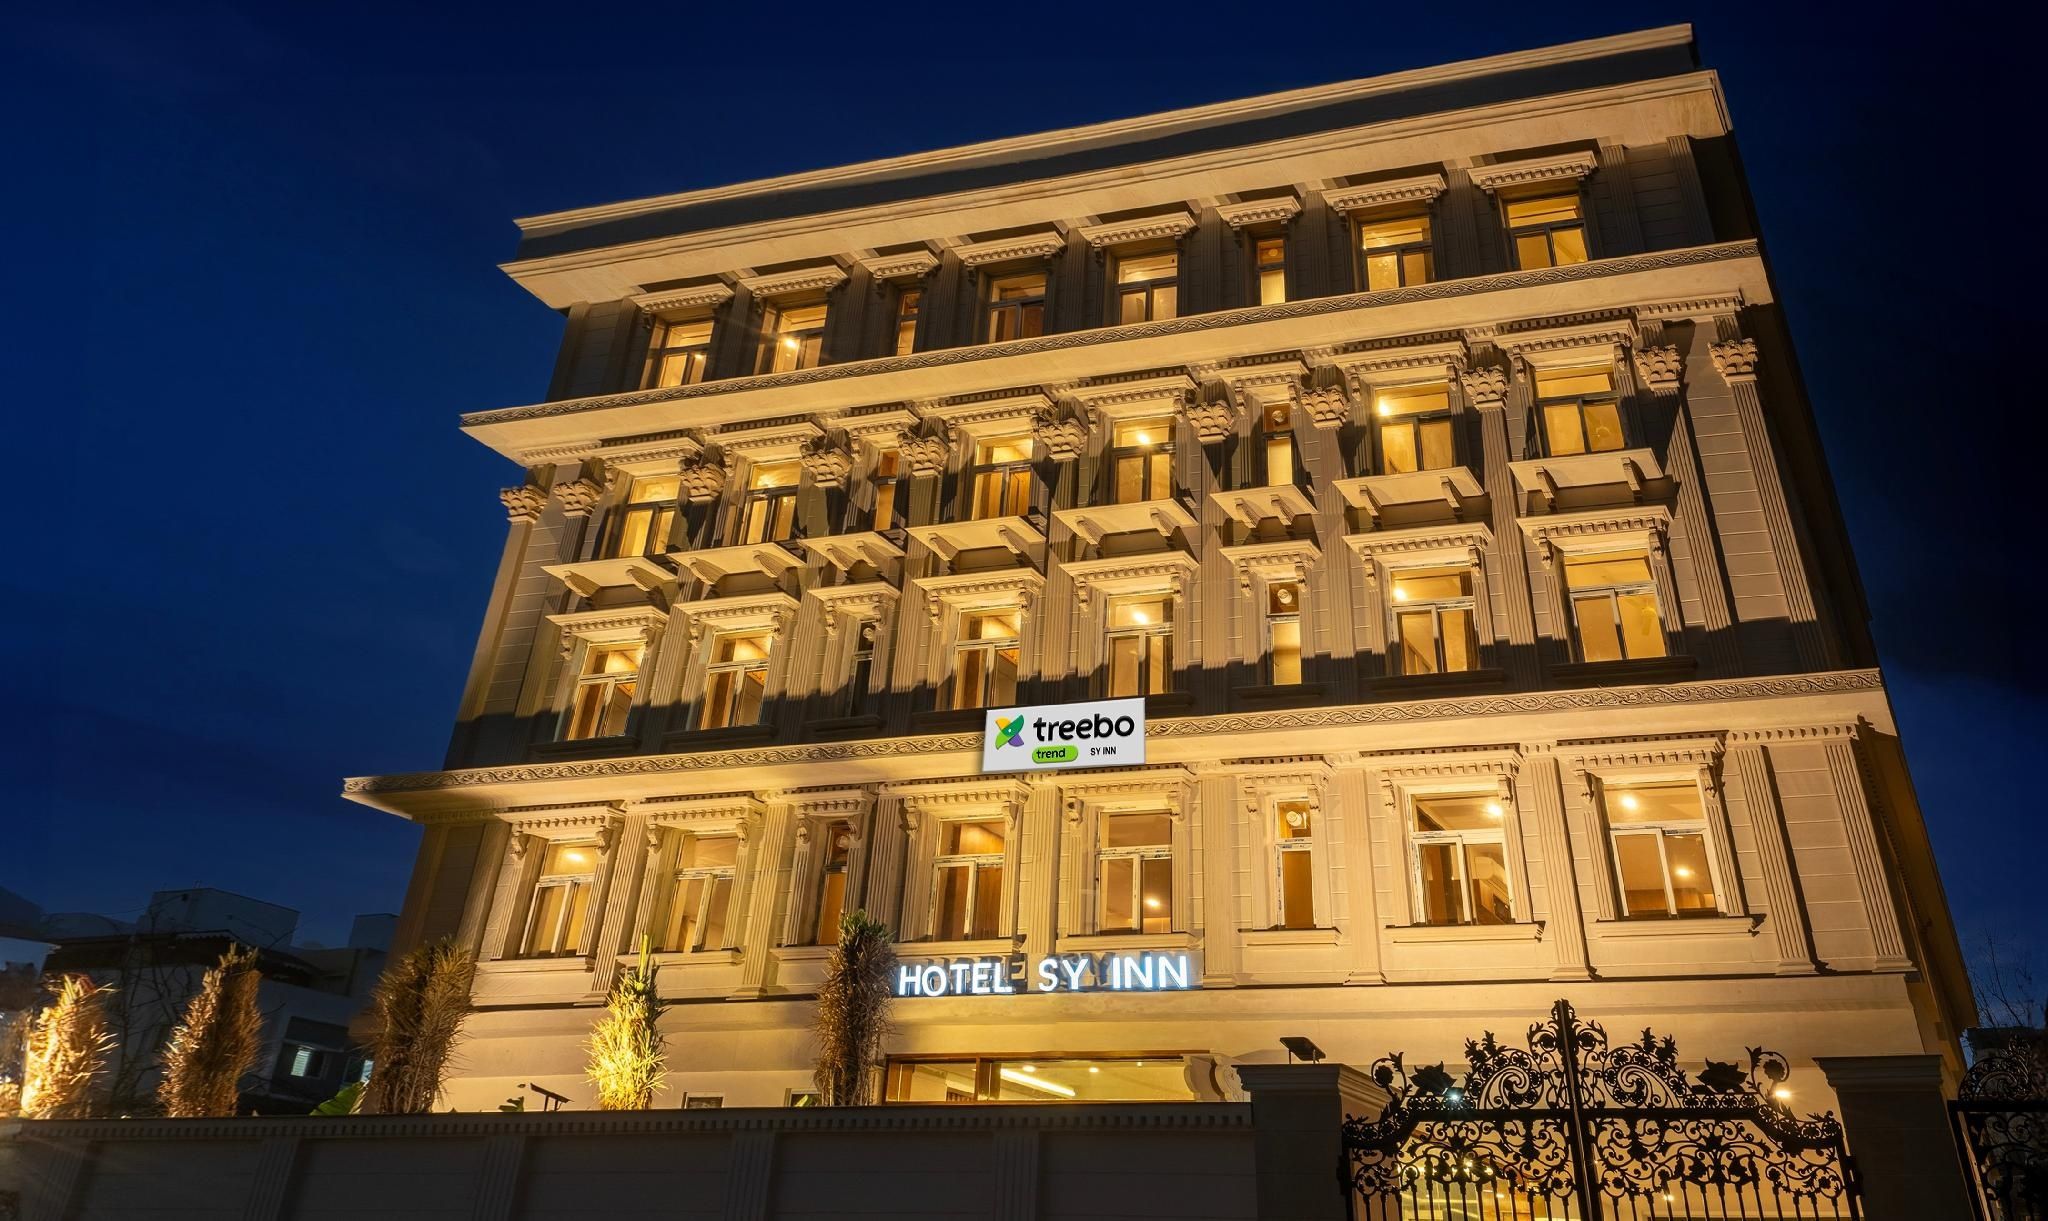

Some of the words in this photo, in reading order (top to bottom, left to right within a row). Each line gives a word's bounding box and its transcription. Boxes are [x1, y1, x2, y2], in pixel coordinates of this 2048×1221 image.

[1033, 713, 1135, 742] treebo
[1036, 748, 1066, 759] trend
[1090, 747, 1101, 756] SY
[1102, 746, 1117, 755] INN
[899, 962, 1013, 996] HOTEL
[1038, 957, 1089, 992] SY
[1112, 955, 1188, 990] INN
